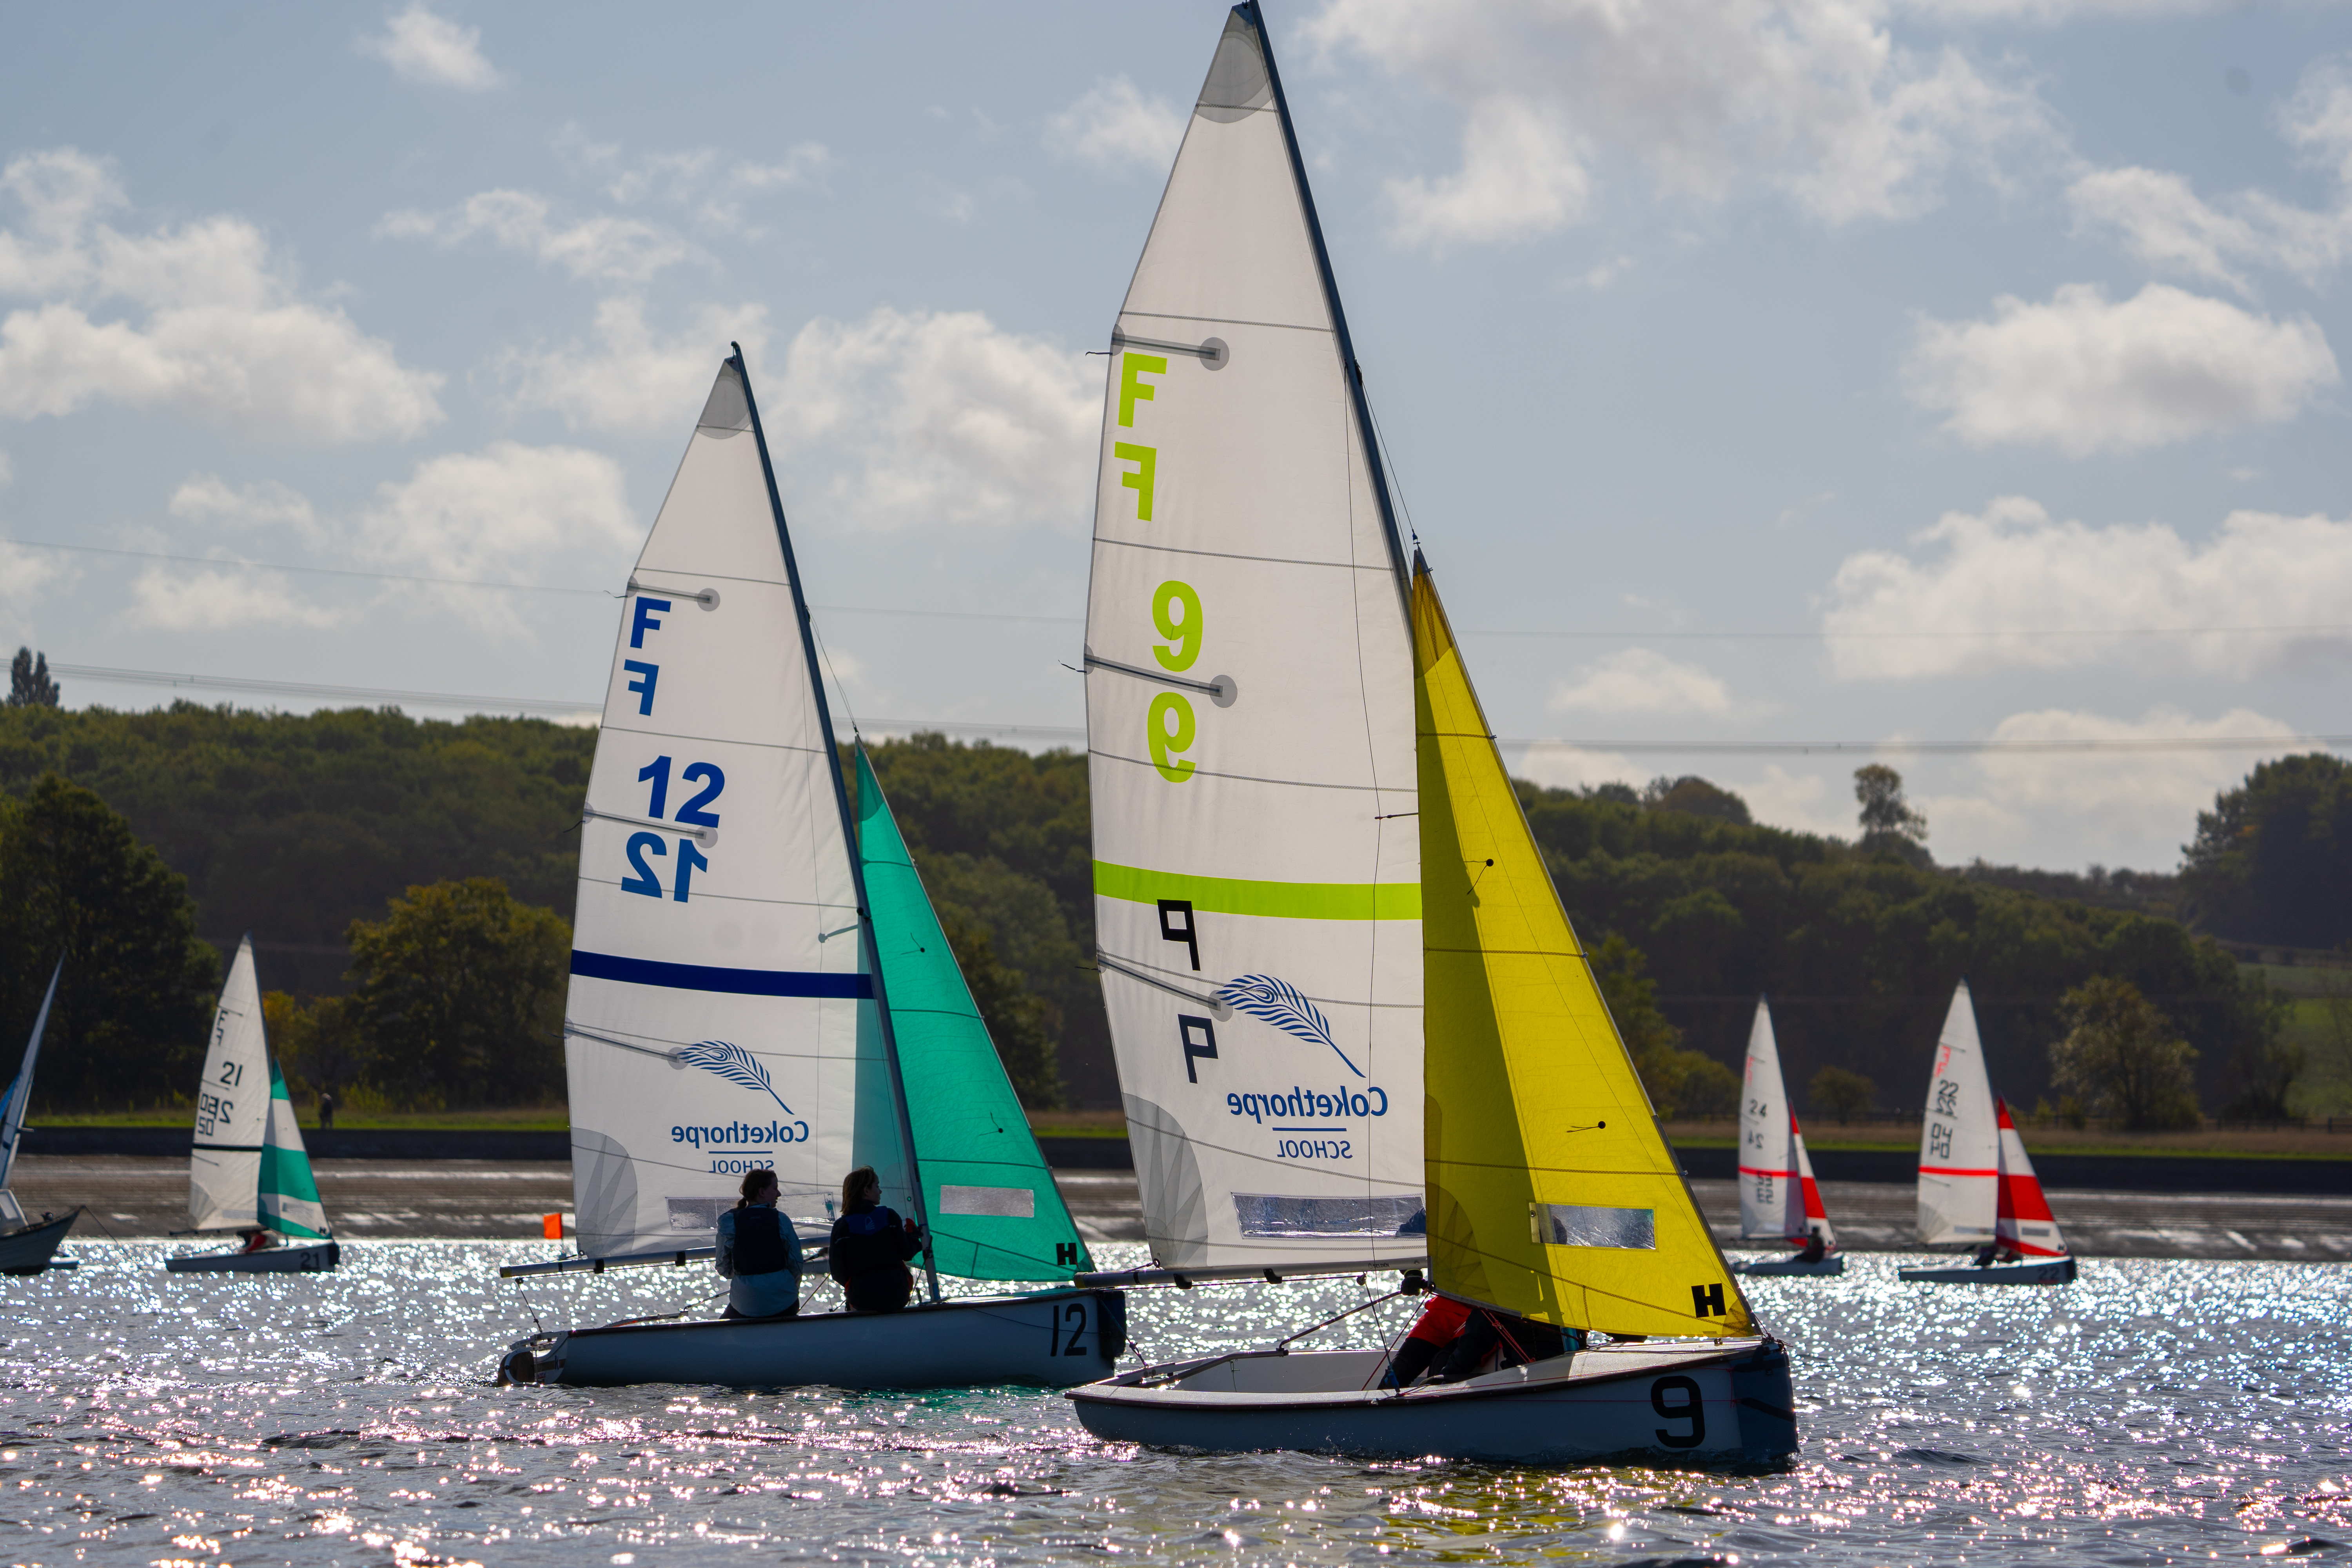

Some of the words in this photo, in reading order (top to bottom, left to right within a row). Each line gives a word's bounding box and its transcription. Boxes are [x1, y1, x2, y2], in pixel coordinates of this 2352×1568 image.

[1119, 352, 1167, 427] F
[630, 596, 671, 649] F
[1152, 580, 1203, 672] 9
[638, 755, 725, 828] 12
[217, 1010, 229, 1026] F
[220, 1061, 243, 1087] 21
[1939, 1079, 1959, 1099] 22
[1750, 1098, 1768, 1118] 24
[300, 1252, 319, 1270] 21
[1056, 1243, 1078, 1266] H
[2038, 1266, 2059, 1282] 22
[1691, 1283, 1727, 1318] H
[1050, 1303, 1087, 1357] 12
[1650, 1375, 1706, 1448] 9
